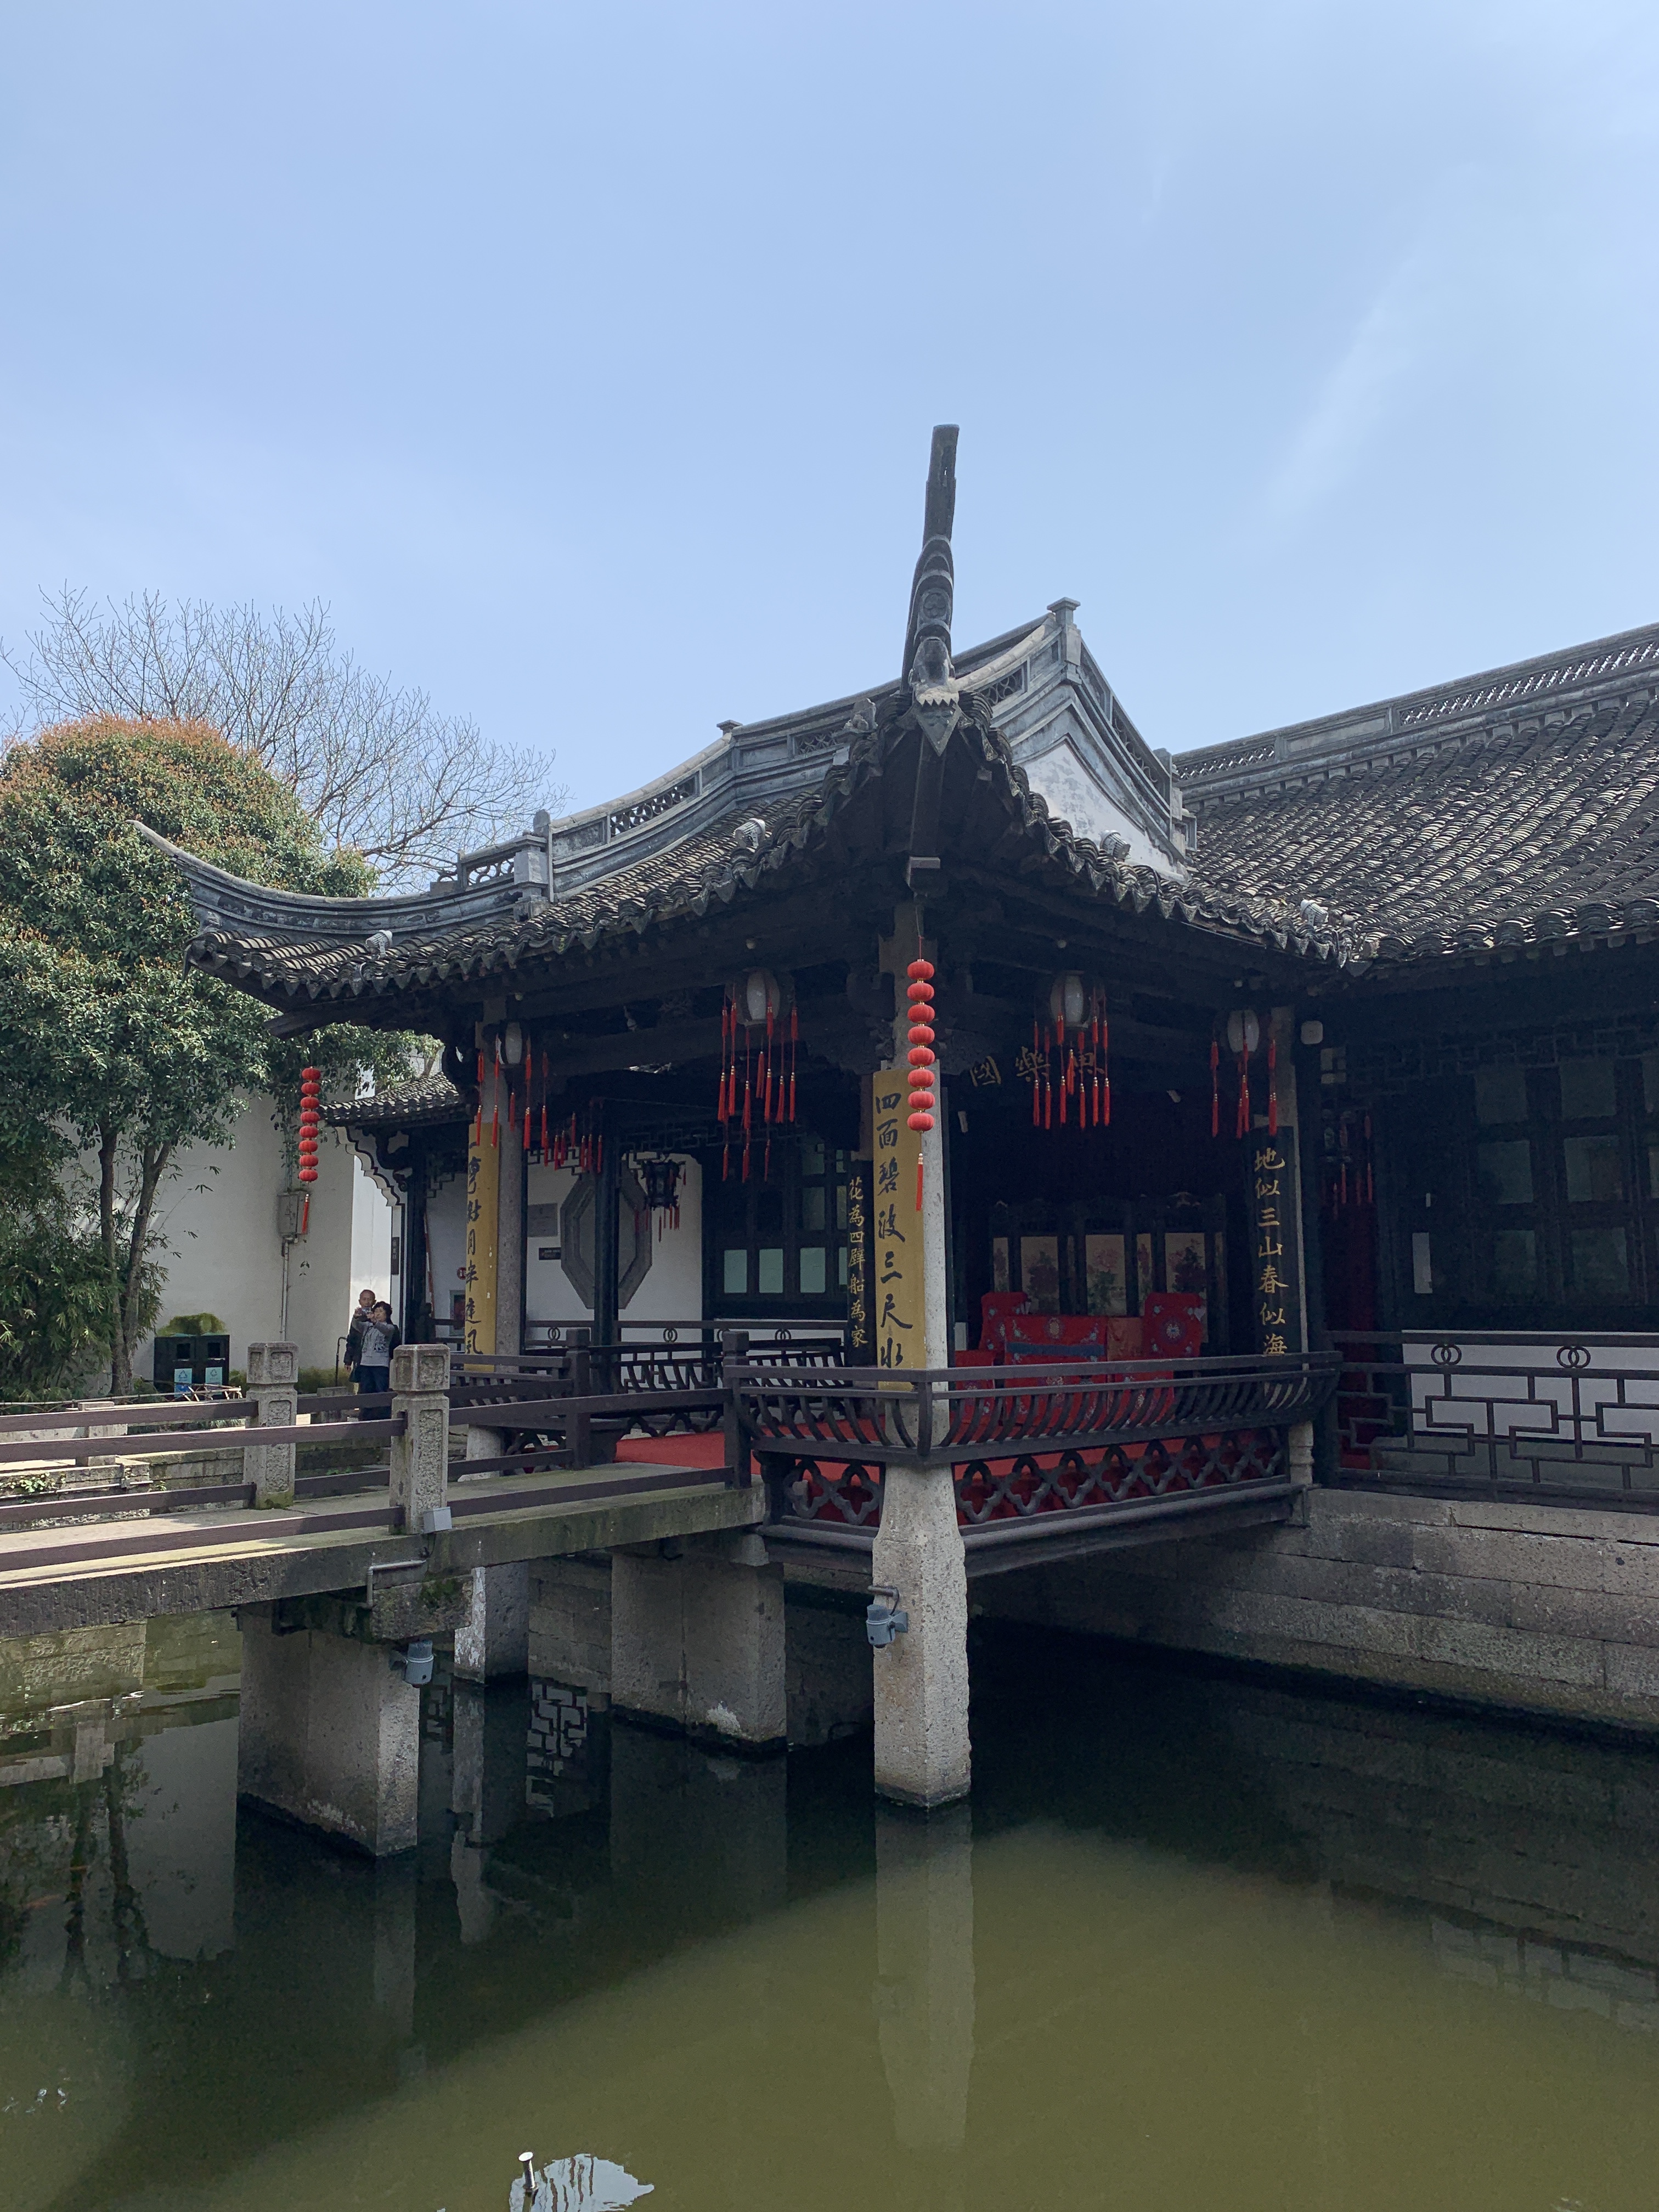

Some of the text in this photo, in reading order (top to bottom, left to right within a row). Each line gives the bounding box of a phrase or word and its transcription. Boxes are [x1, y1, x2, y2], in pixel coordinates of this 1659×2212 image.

[875, 1092, 913, 1369] 四面碧波三尺水
[1254, 1147, 1289, 1356] 地似三山春似海
